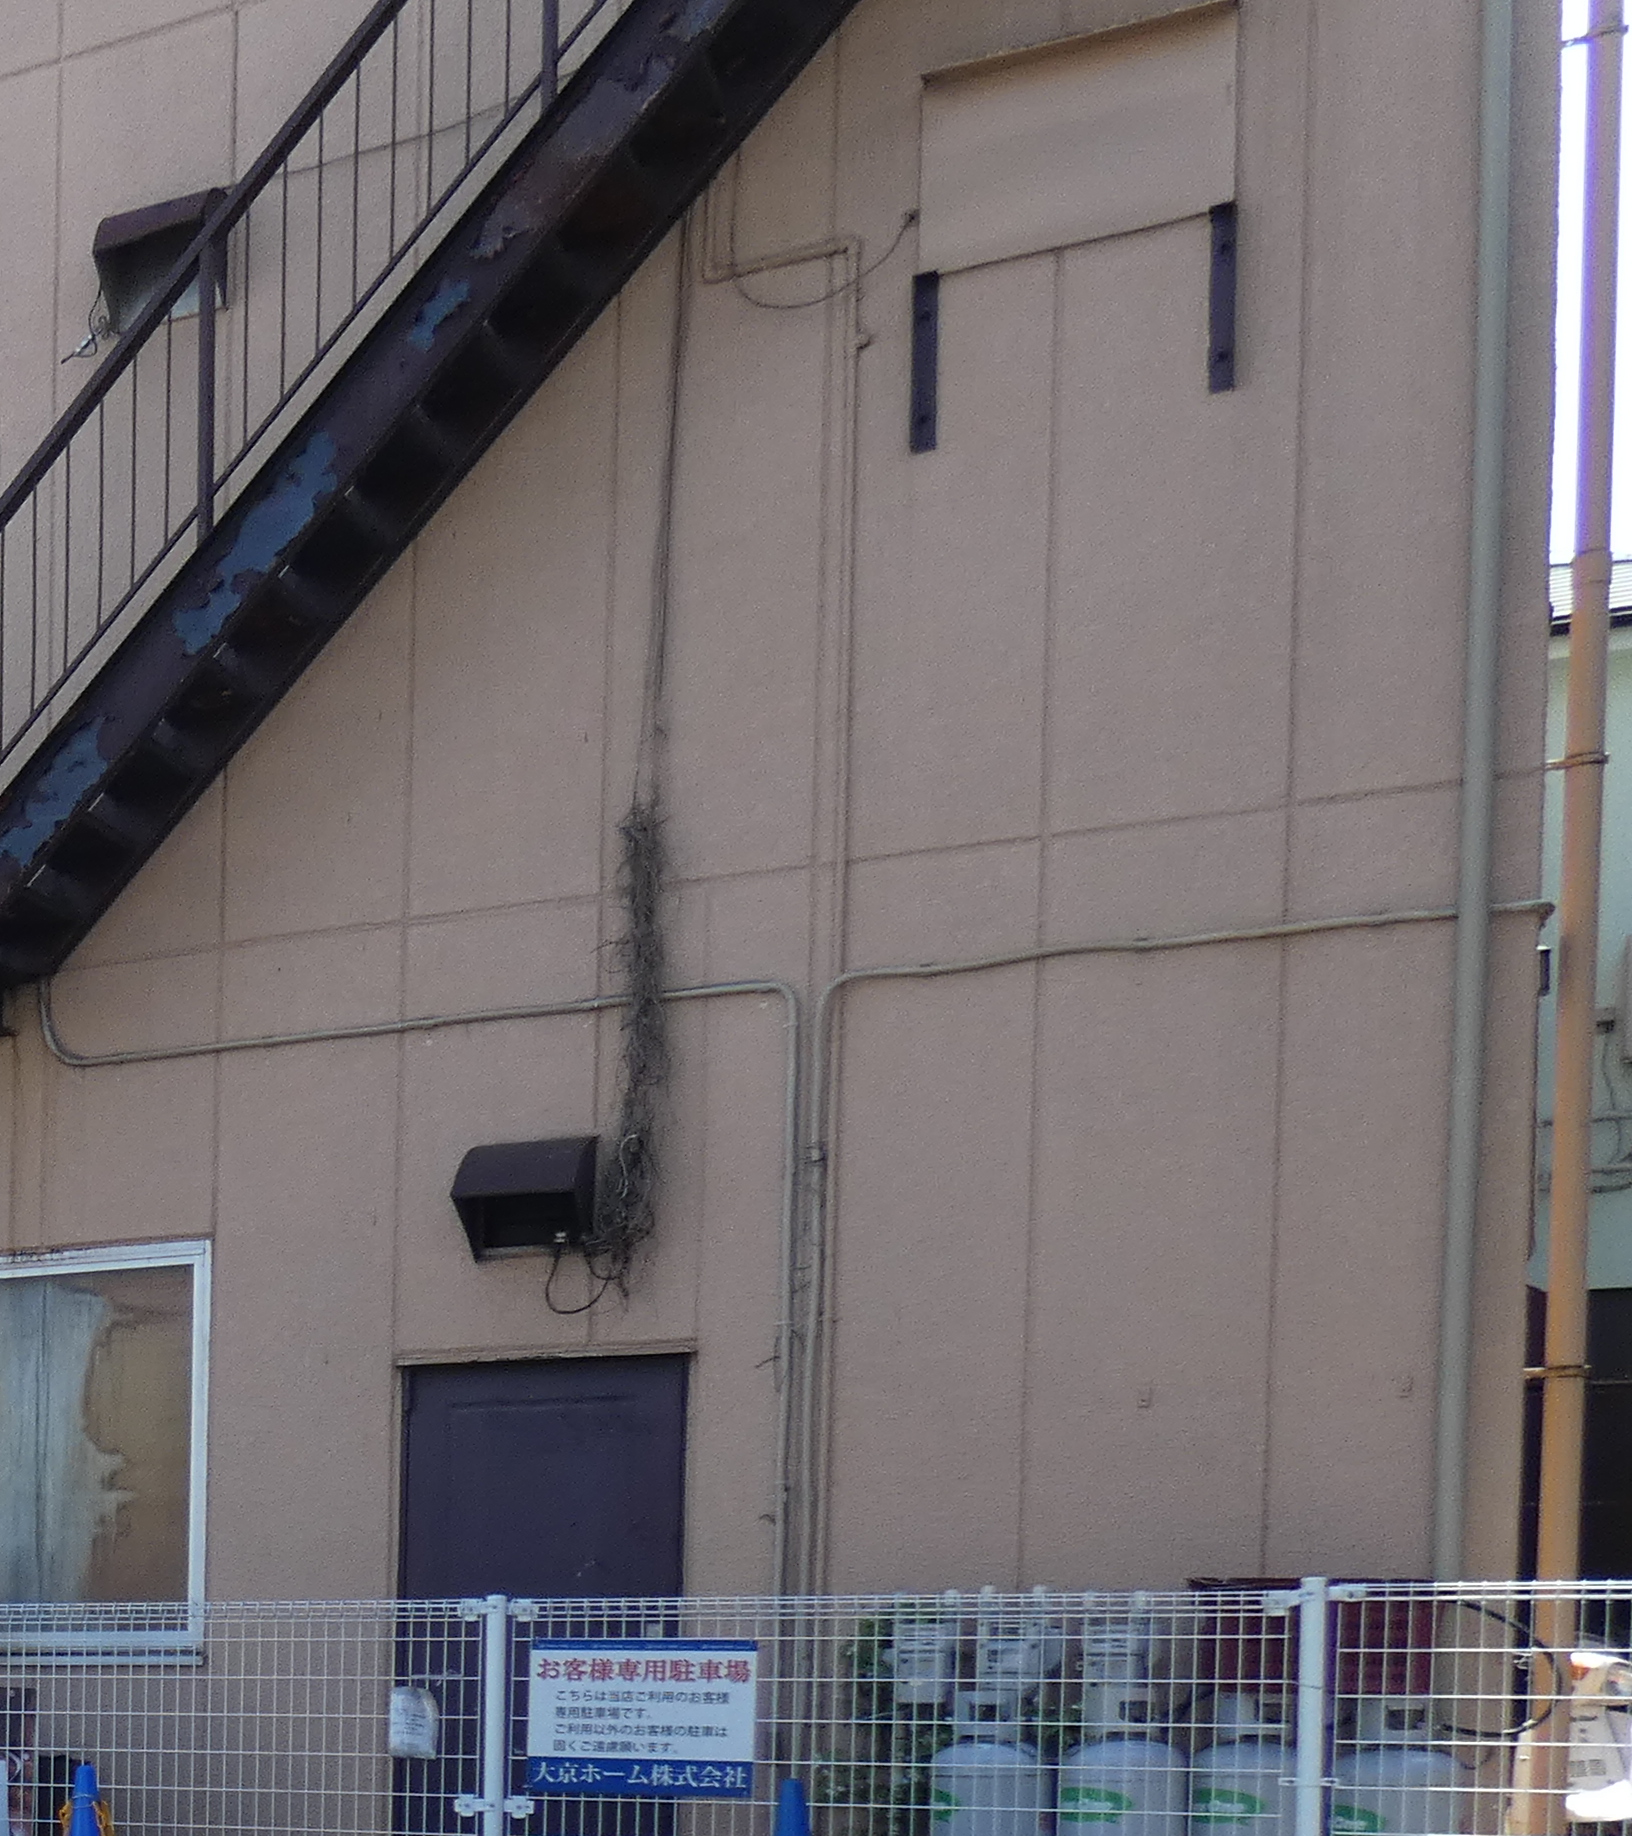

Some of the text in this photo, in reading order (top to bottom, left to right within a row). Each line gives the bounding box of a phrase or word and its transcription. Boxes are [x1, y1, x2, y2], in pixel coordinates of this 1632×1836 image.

[537, 1658, 752, 1684] お客様専用駐車場
[555, 1690, 730, 1704] こちらは当店ご利用のお客様
[555, 1706, 652, 1720] 専用駐車場です。
[554, 1723, 729, 1738] ご利用以外のお客様の駐車は
[534, 1762, 748, 1788] 大京ホーム株式会社
